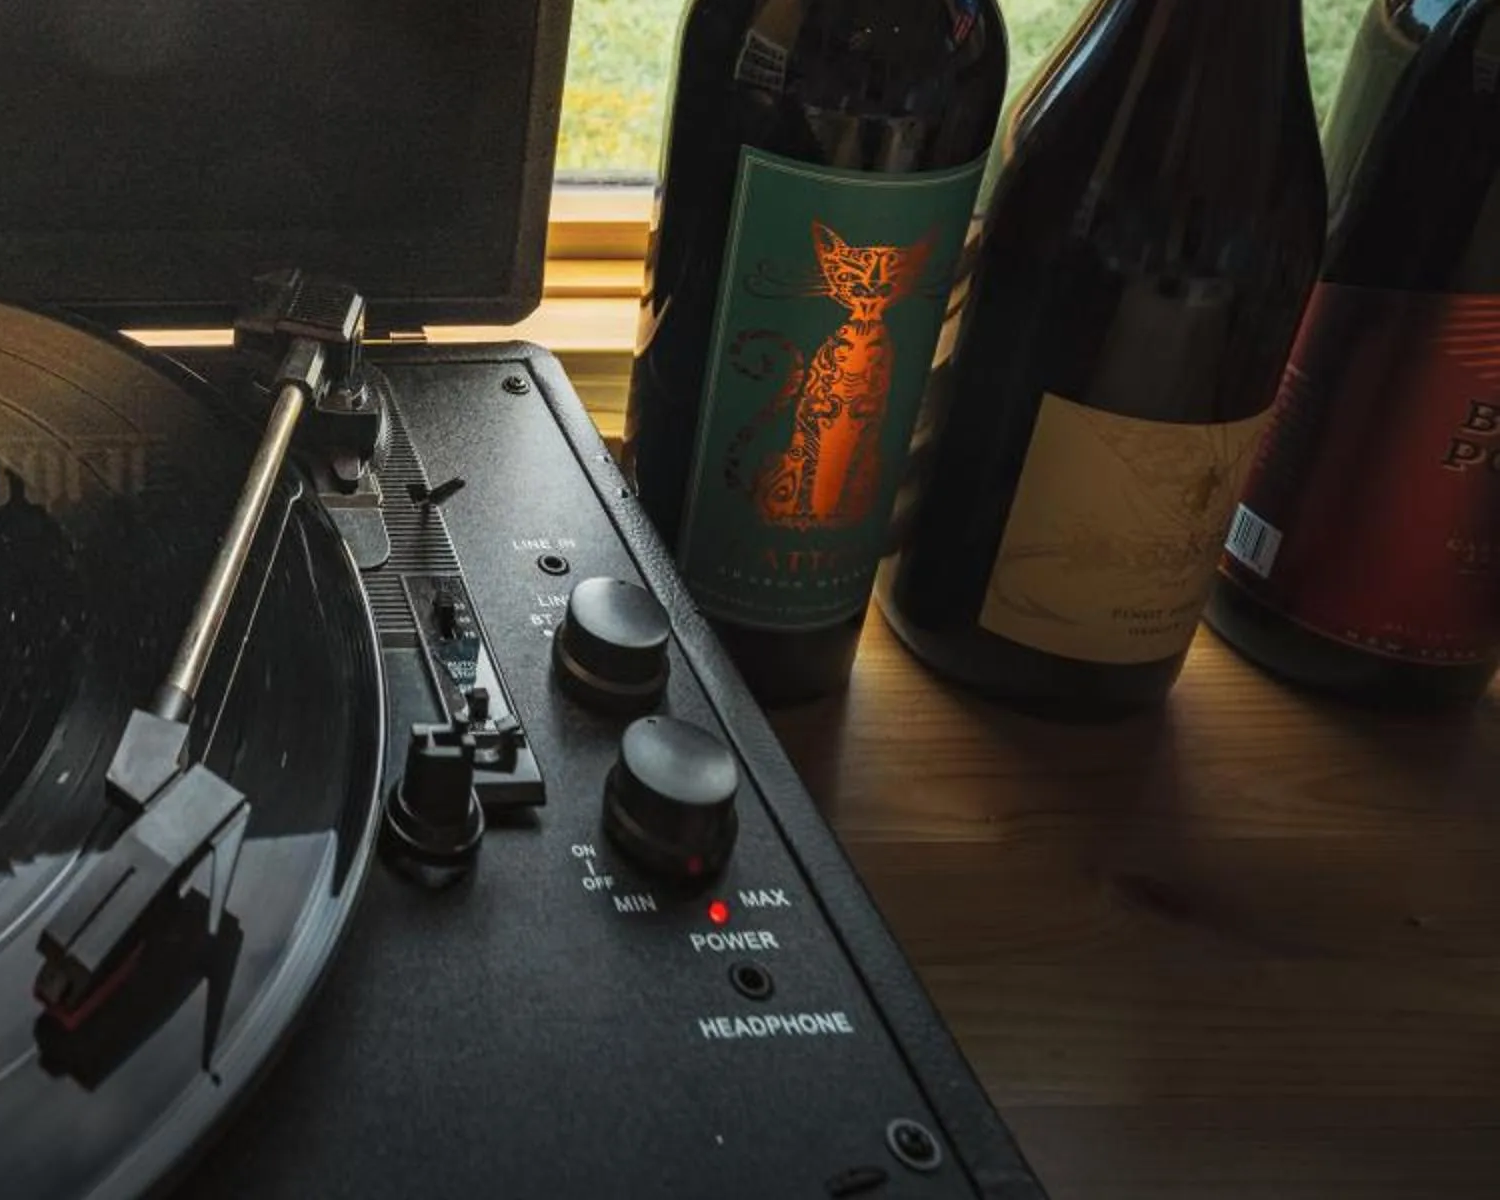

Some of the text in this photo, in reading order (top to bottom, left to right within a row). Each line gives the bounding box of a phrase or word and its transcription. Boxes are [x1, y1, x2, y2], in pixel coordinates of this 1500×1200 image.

[536, 593, 569, 607] LIN
[571, 843, 597, 858] ON
[581, 875, 615, 892] OFF
[612, 893, 658, 913] MIN
[738, 888, 792, 908] MAX
[689, 929, 780, 952] POWER
[699, 1011, 854, 1040] HEADPHONE
